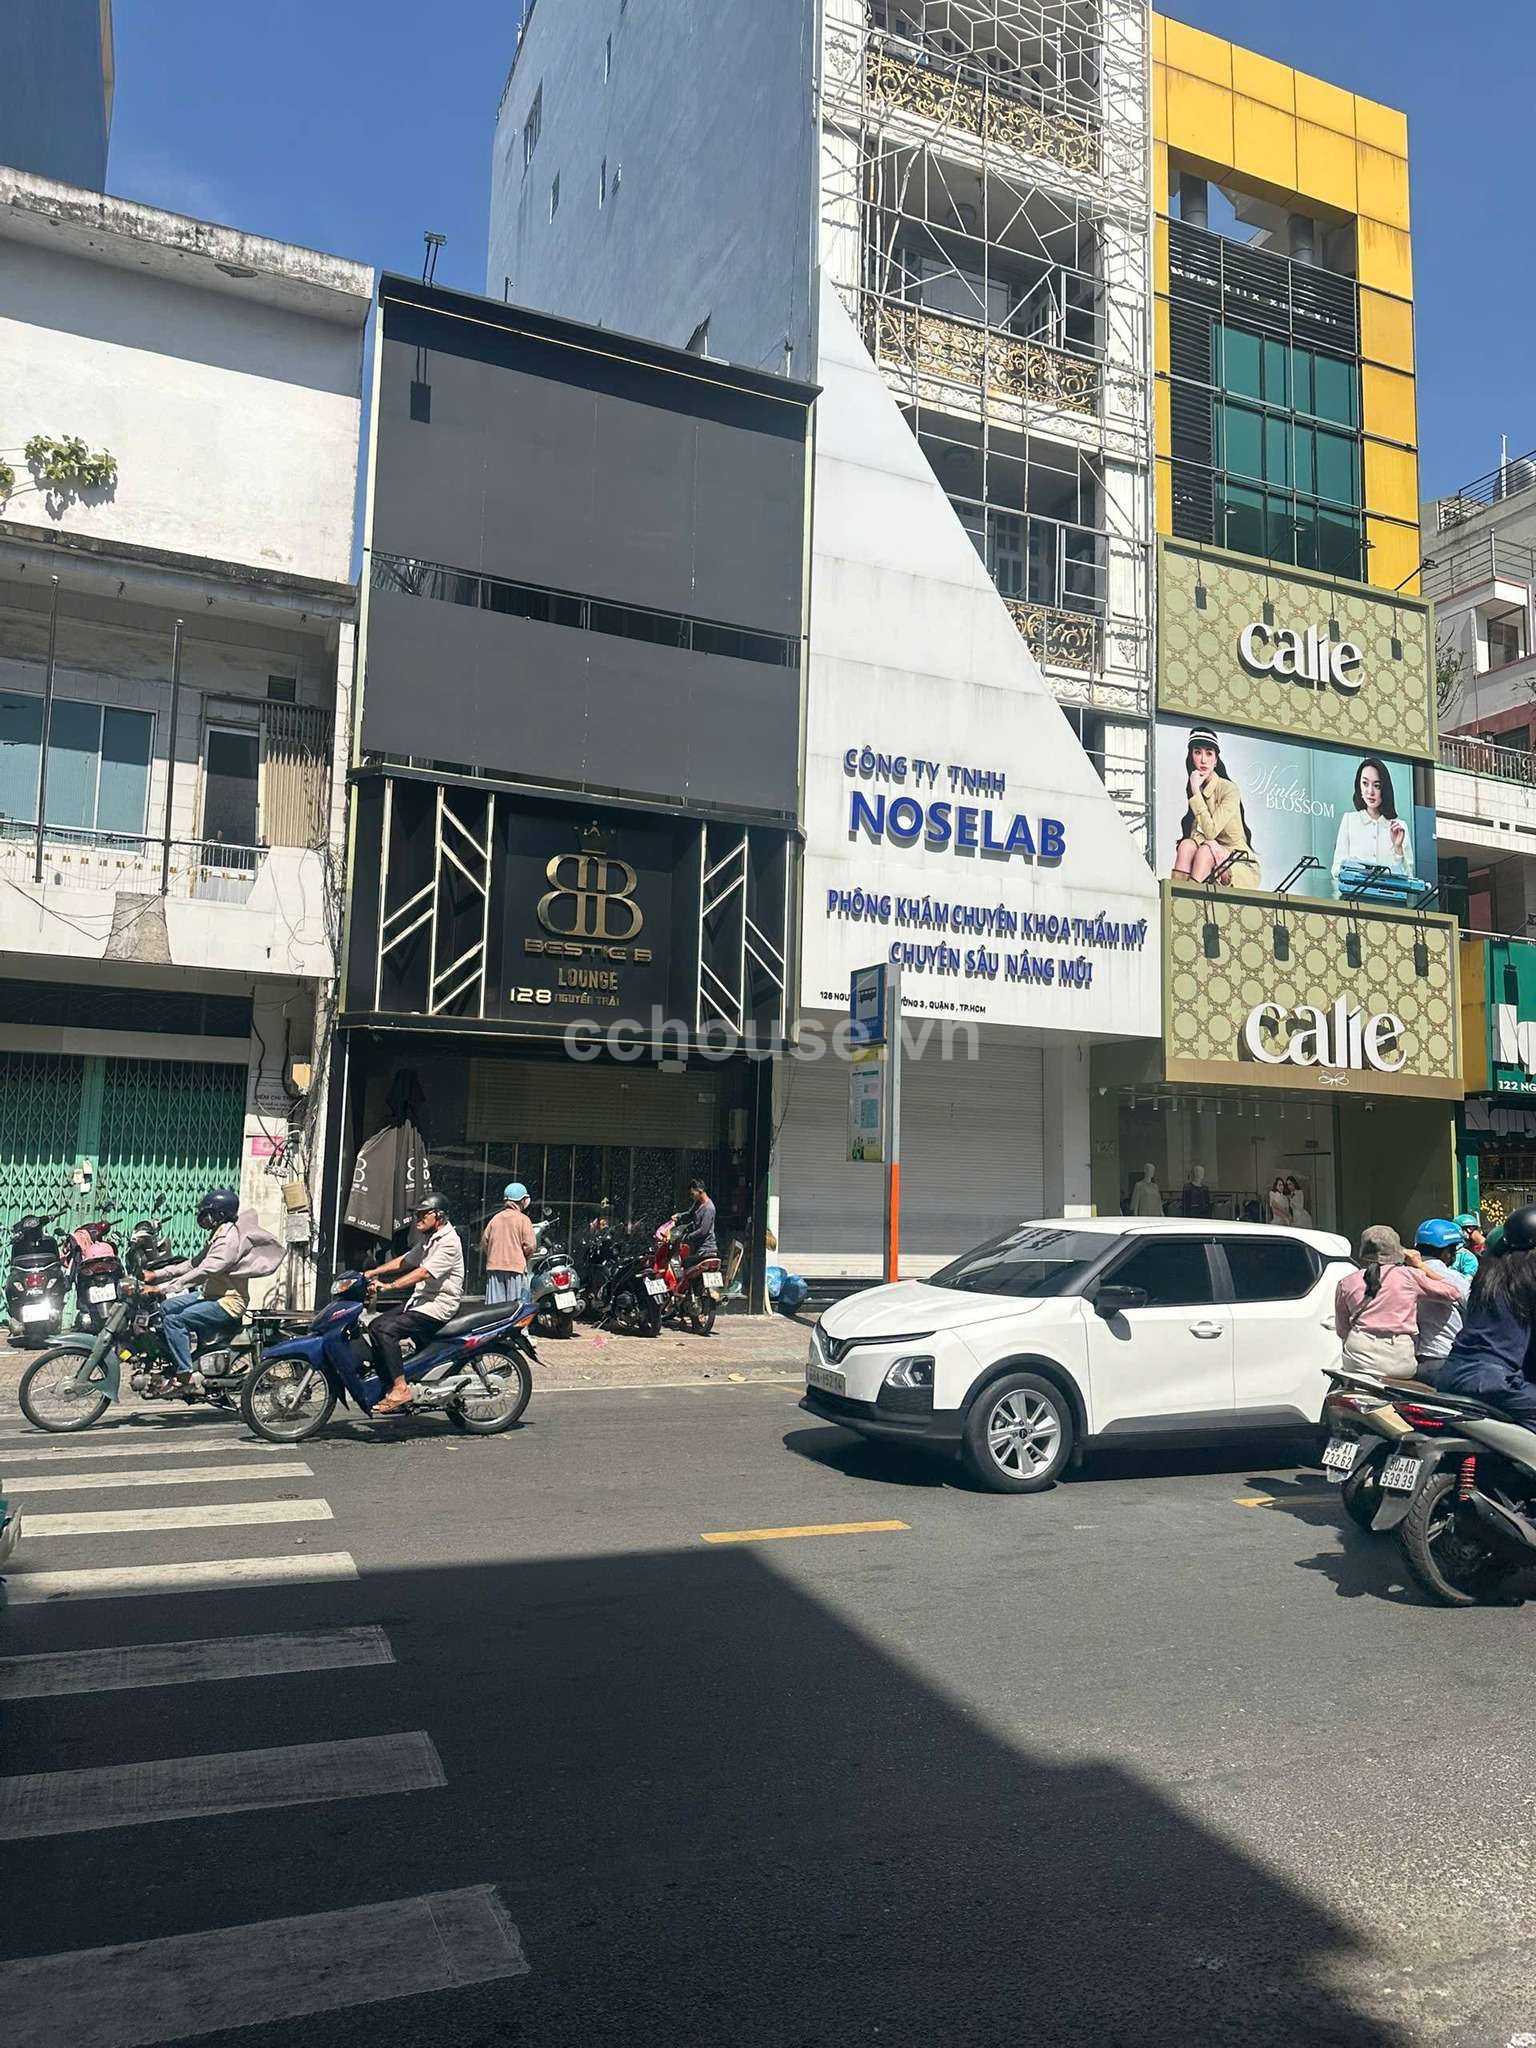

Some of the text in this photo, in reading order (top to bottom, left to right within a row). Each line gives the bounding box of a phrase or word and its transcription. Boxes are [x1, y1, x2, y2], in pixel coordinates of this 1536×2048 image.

[844, 745, 1005, 793] CÔNG TY TNHH
[1266, 793, 1335, 818] BLOSSOM
[851, 790, 1067, 858] NOSELAB
[895, 895, 949, 924] KHÁM
[952, 903, 1018, 931] CHUYÊN
[1022, 912, 1071, 937] KHOA
[524, 938, 626, 959] BESTIE
[889, 940, 961, 970] CHUYÊN
[965, 945, 999, 974] SÂU
[1004, 949, 1055, 978] NÂNG
[558, 968, 618, 990] LOUNGE
[510, 986, 551, 1004] 128
[1498, 1080, 1518, 1091] 122
